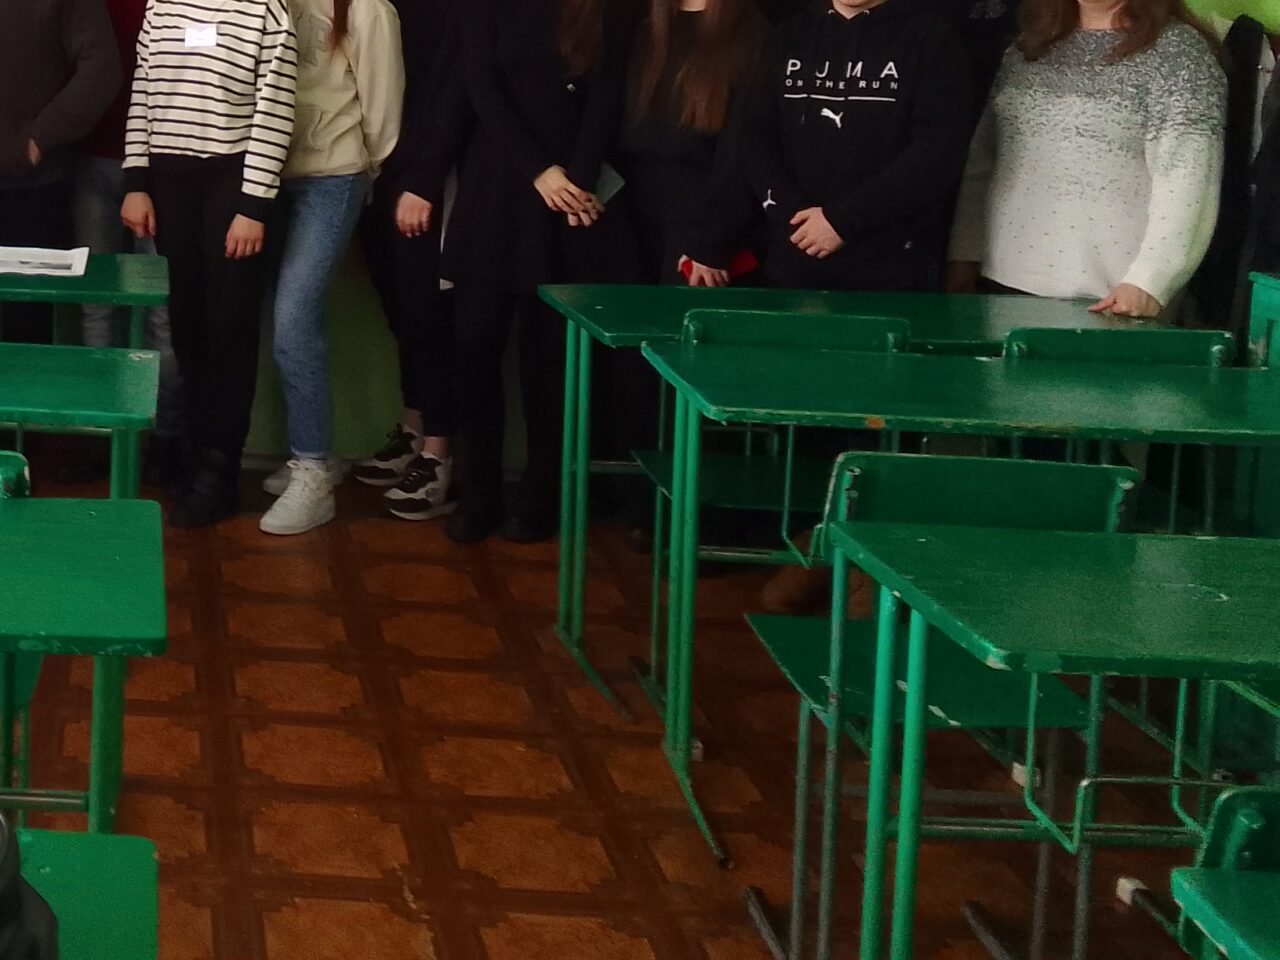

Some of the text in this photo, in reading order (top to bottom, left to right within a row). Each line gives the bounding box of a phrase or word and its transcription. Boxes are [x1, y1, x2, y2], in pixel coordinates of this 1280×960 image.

[785, 78, 899, 91] ON THE RUN
